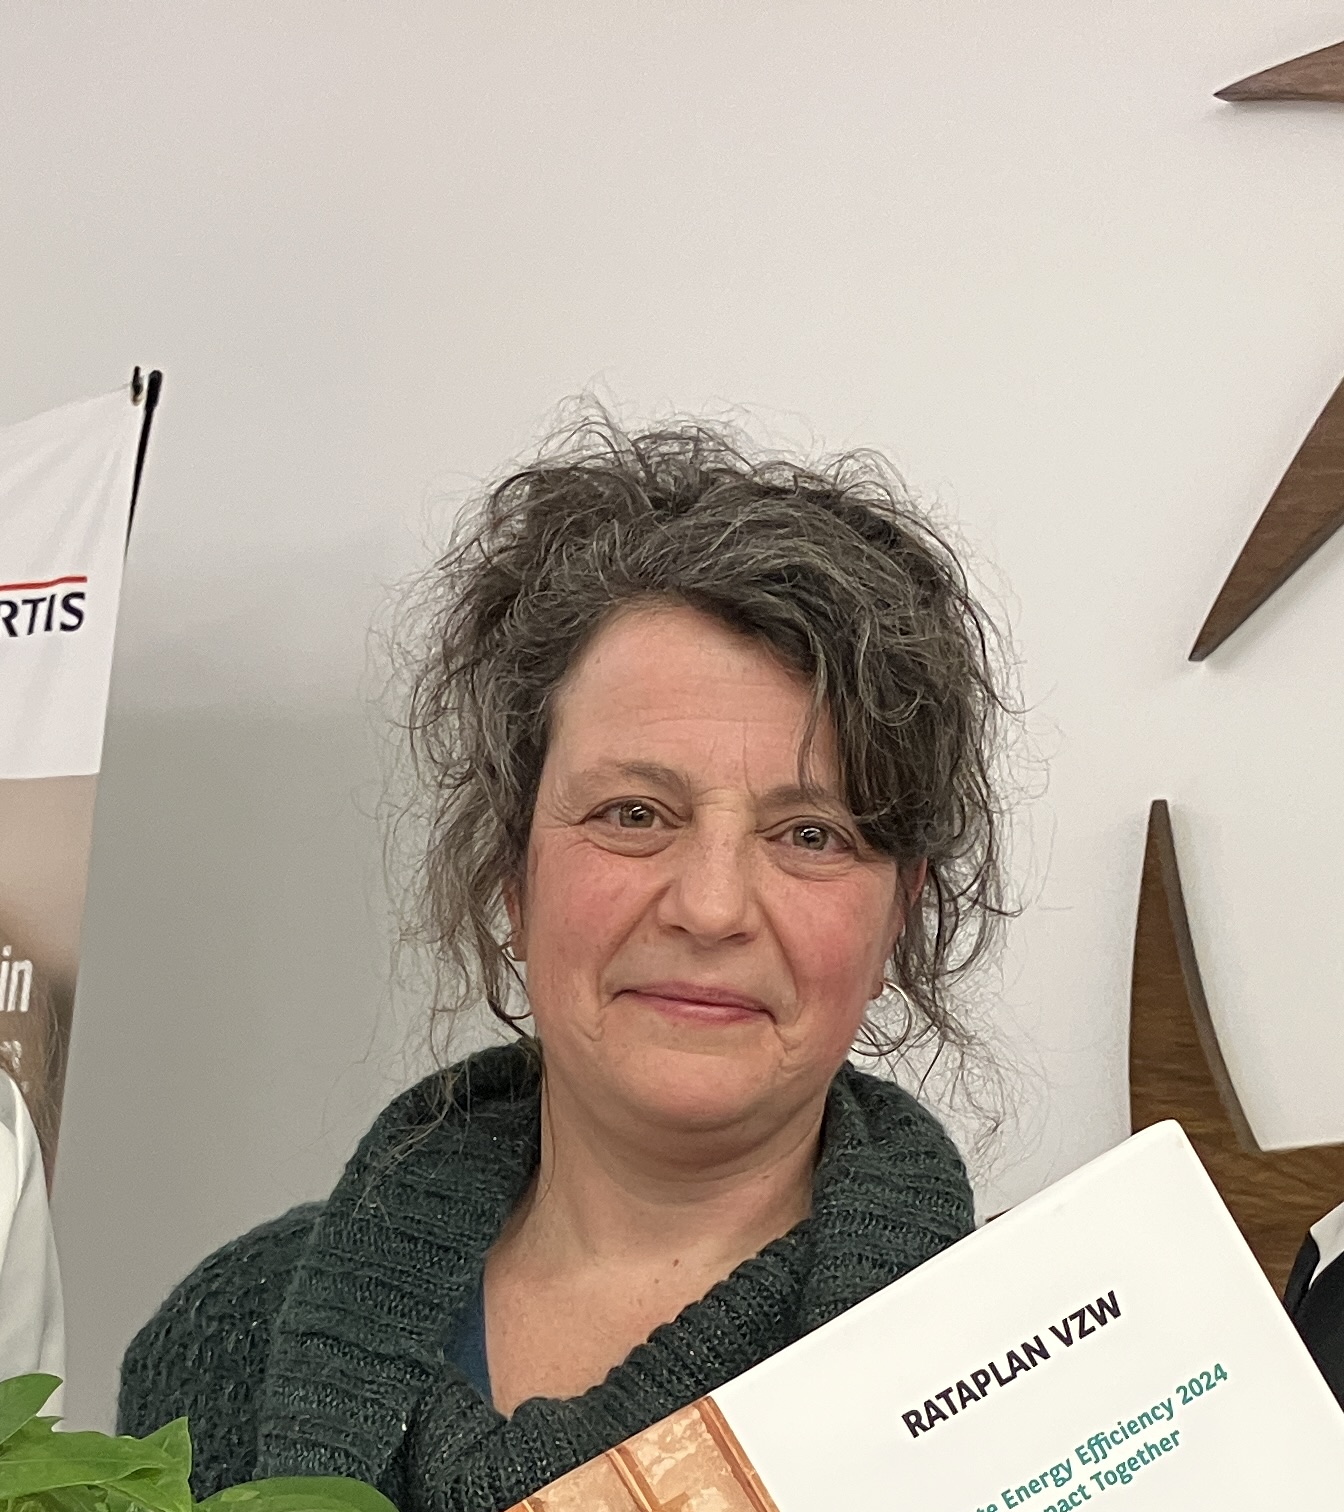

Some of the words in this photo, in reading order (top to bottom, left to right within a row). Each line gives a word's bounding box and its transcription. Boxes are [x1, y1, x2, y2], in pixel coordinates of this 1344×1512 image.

[901, 1334, 1051, 1438] RATAPLAN
[1048, 1290, 1122, 1348] VZW
[1001, 1457, 1074, 1510] Energy
[1075, 1396, 1175, 1466] Efficiency
[1176, 1363, 1229, 1406] 2024
[1089, 1429, 1182, 1492] Together
